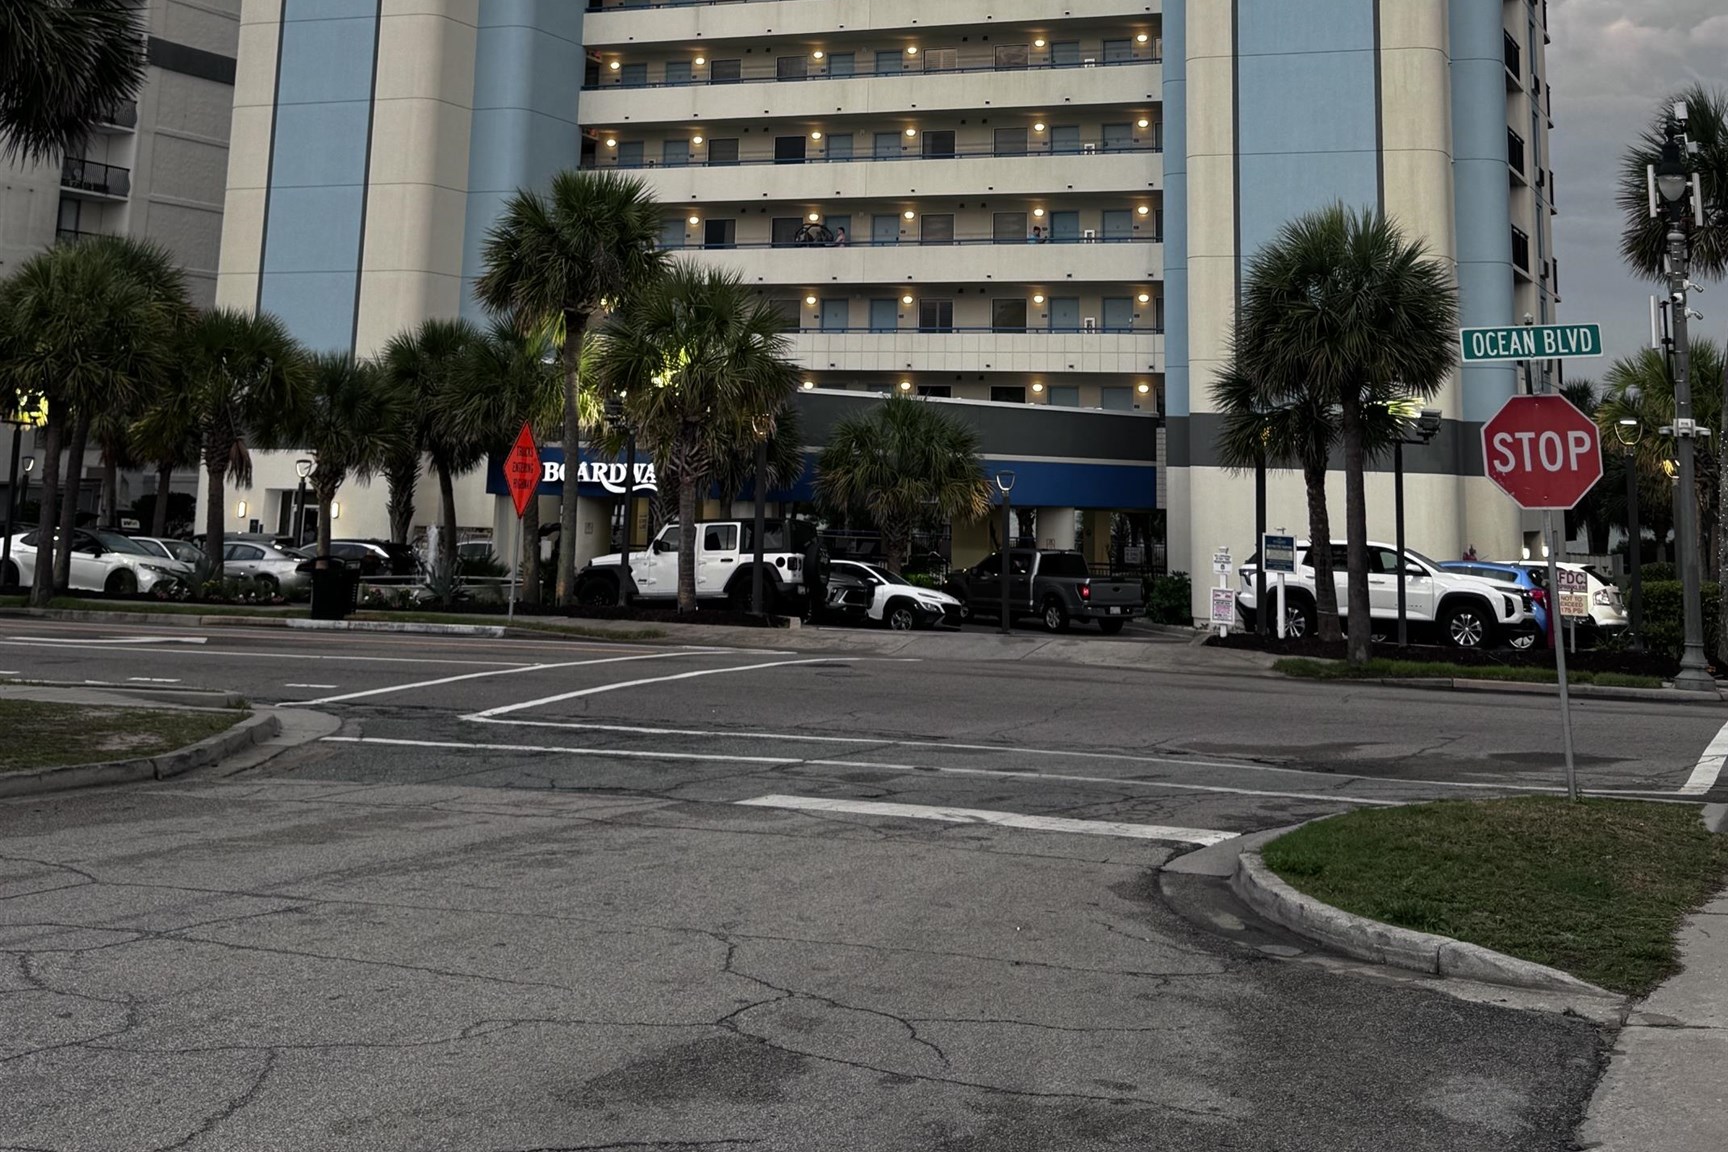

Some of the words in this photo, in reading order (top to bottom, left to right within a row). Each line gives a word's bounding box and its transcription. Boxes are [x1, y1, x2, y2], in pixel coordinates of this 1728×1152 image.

[1472, 330, 1536, 357] OCEAN
[1543, 328, 1592, 353] BLVD
[1492, 430, 1592, 473] STOP
[1559, 572, 1584, 584] FDC
